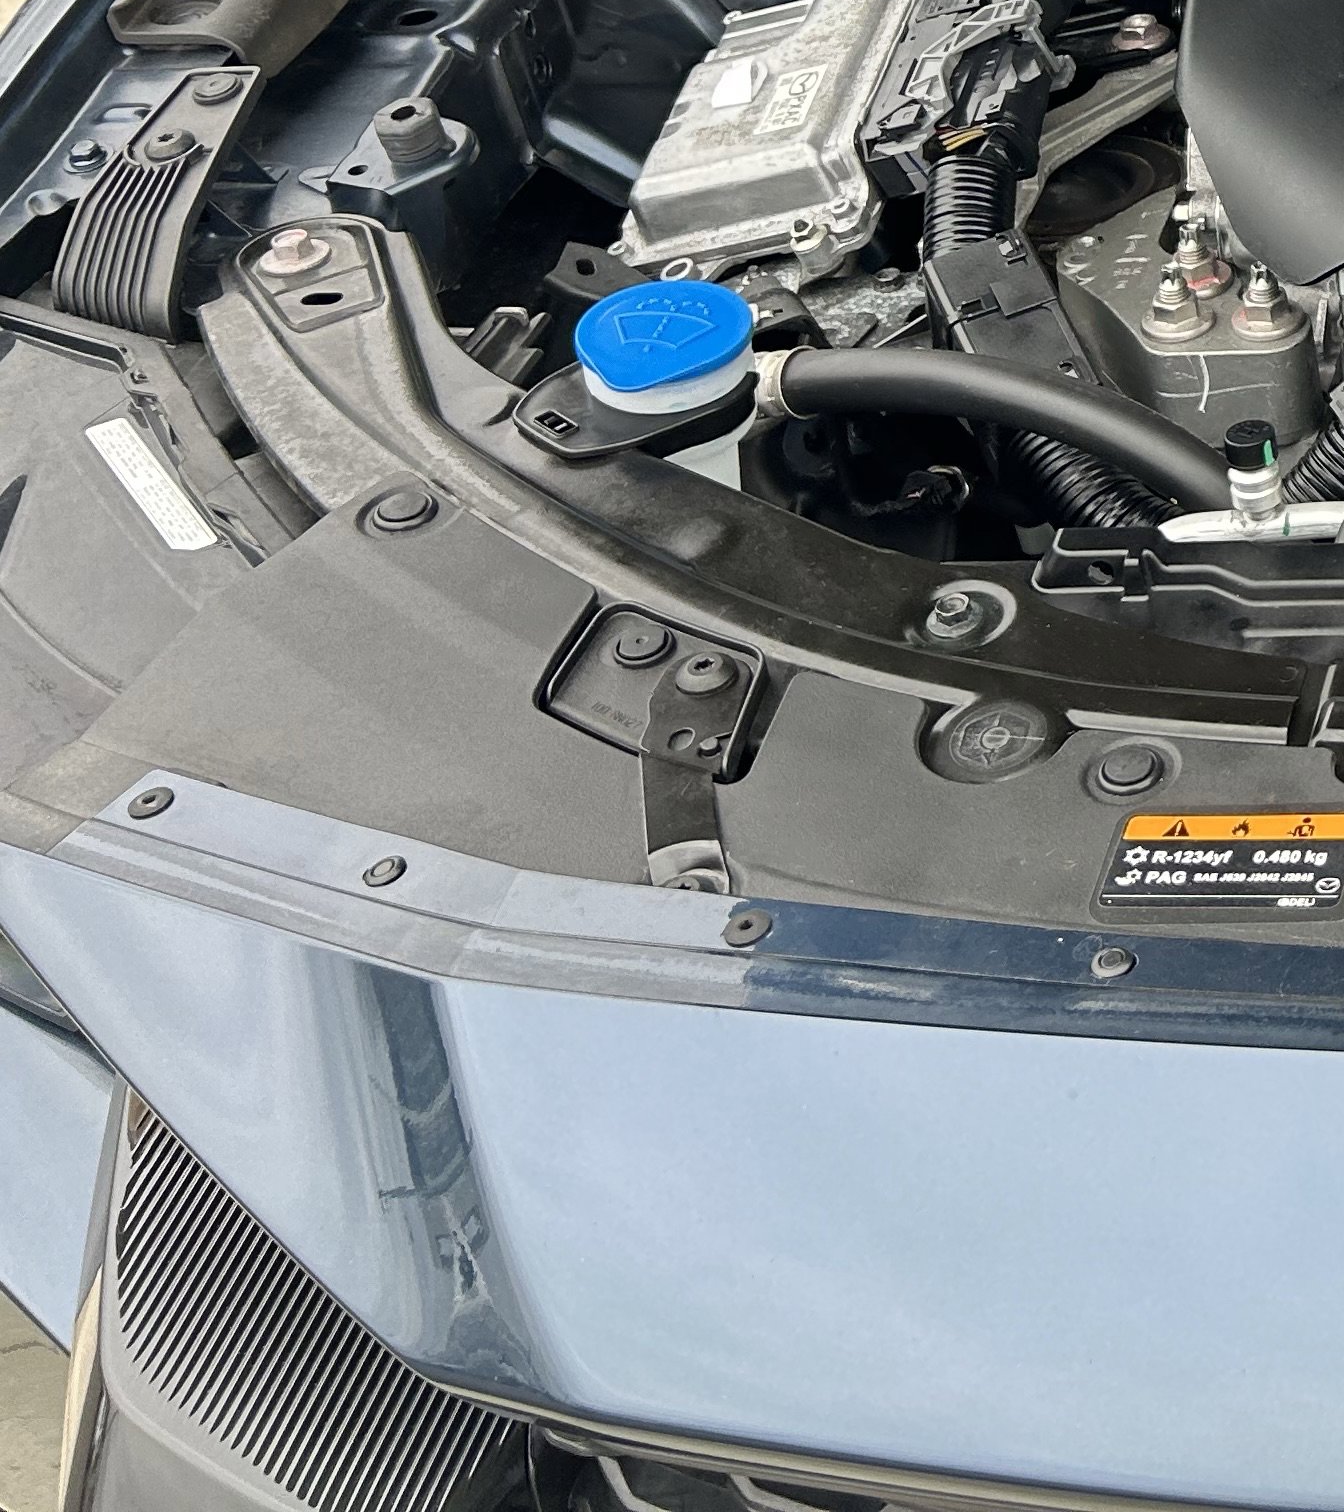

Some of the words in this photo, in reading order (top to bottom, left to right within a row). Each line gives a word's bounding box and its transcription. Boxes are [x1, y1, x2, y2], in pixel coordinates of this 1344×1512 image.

[1151, 850, 1234, 866] R-1234yf
[1303, 849, 1328, 866] kg
[1144, 870, 1187, 885] PAG
